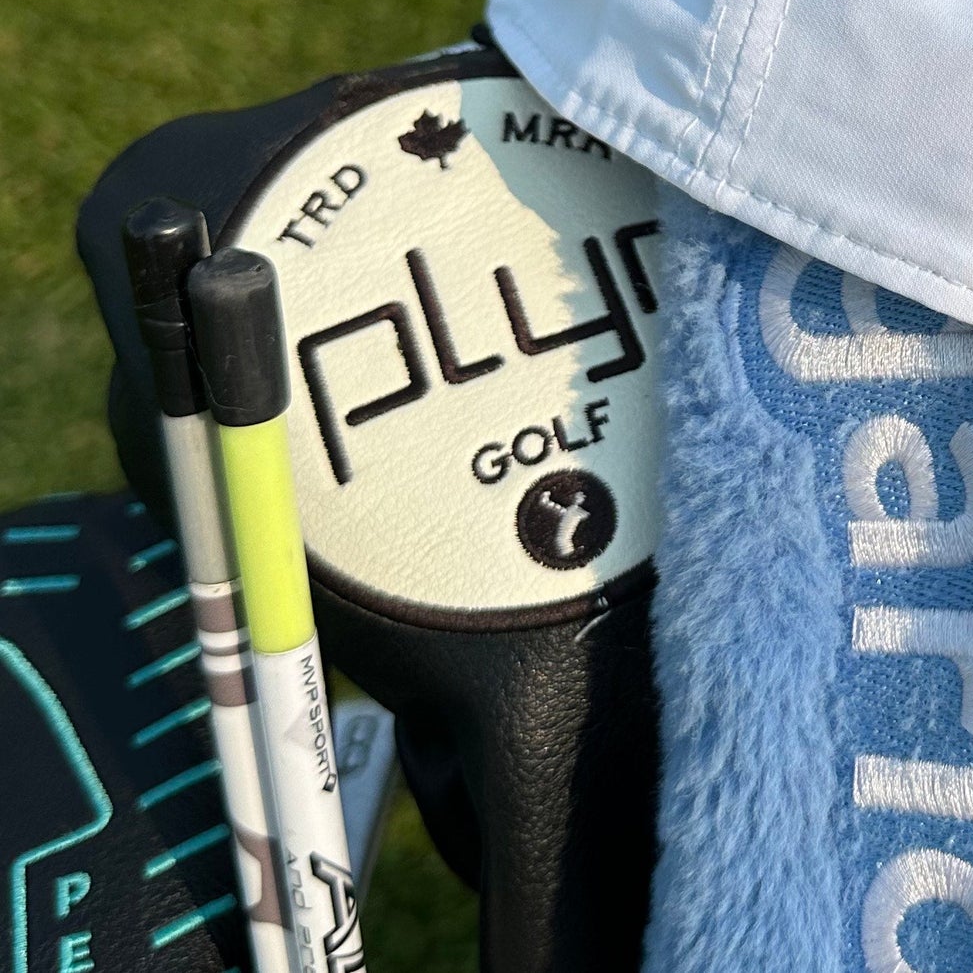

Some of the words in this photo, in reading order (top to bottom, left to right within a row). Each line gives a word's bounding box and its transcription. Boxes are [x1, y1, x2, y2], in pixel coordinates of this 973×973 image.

[471, 397, 610, 484] GOLF
[300, 653, 319, 702] MVP
[309, 703, 333, 775] SPORT
